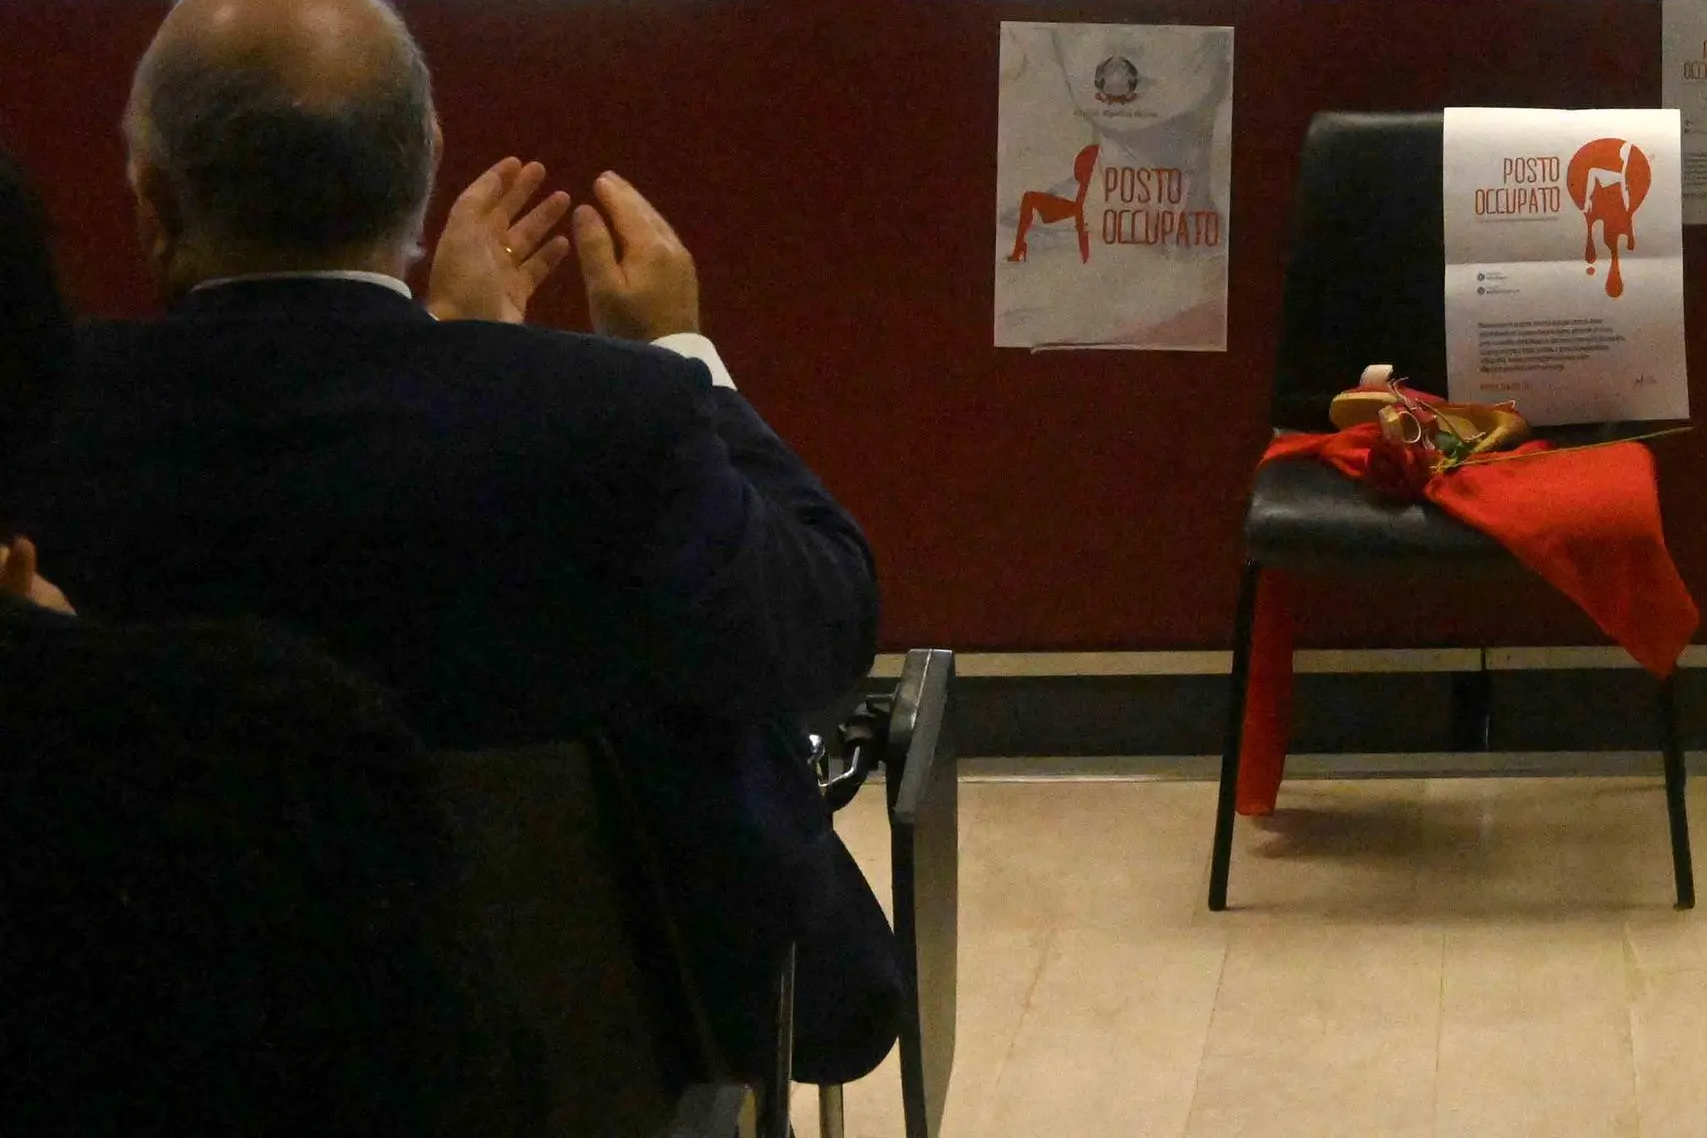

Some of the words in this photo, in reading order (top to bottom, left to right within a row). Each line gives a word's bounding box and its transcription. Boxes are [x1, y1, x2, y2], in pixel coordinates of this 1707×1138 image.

[1104, 167, 1183, 204] POSTO
[1503, 156, 1560, 185] POSTO
[1475, 186, 1561, 216] OCCUPATO
[1102, 209, 1220, 247] OCCUPATO
